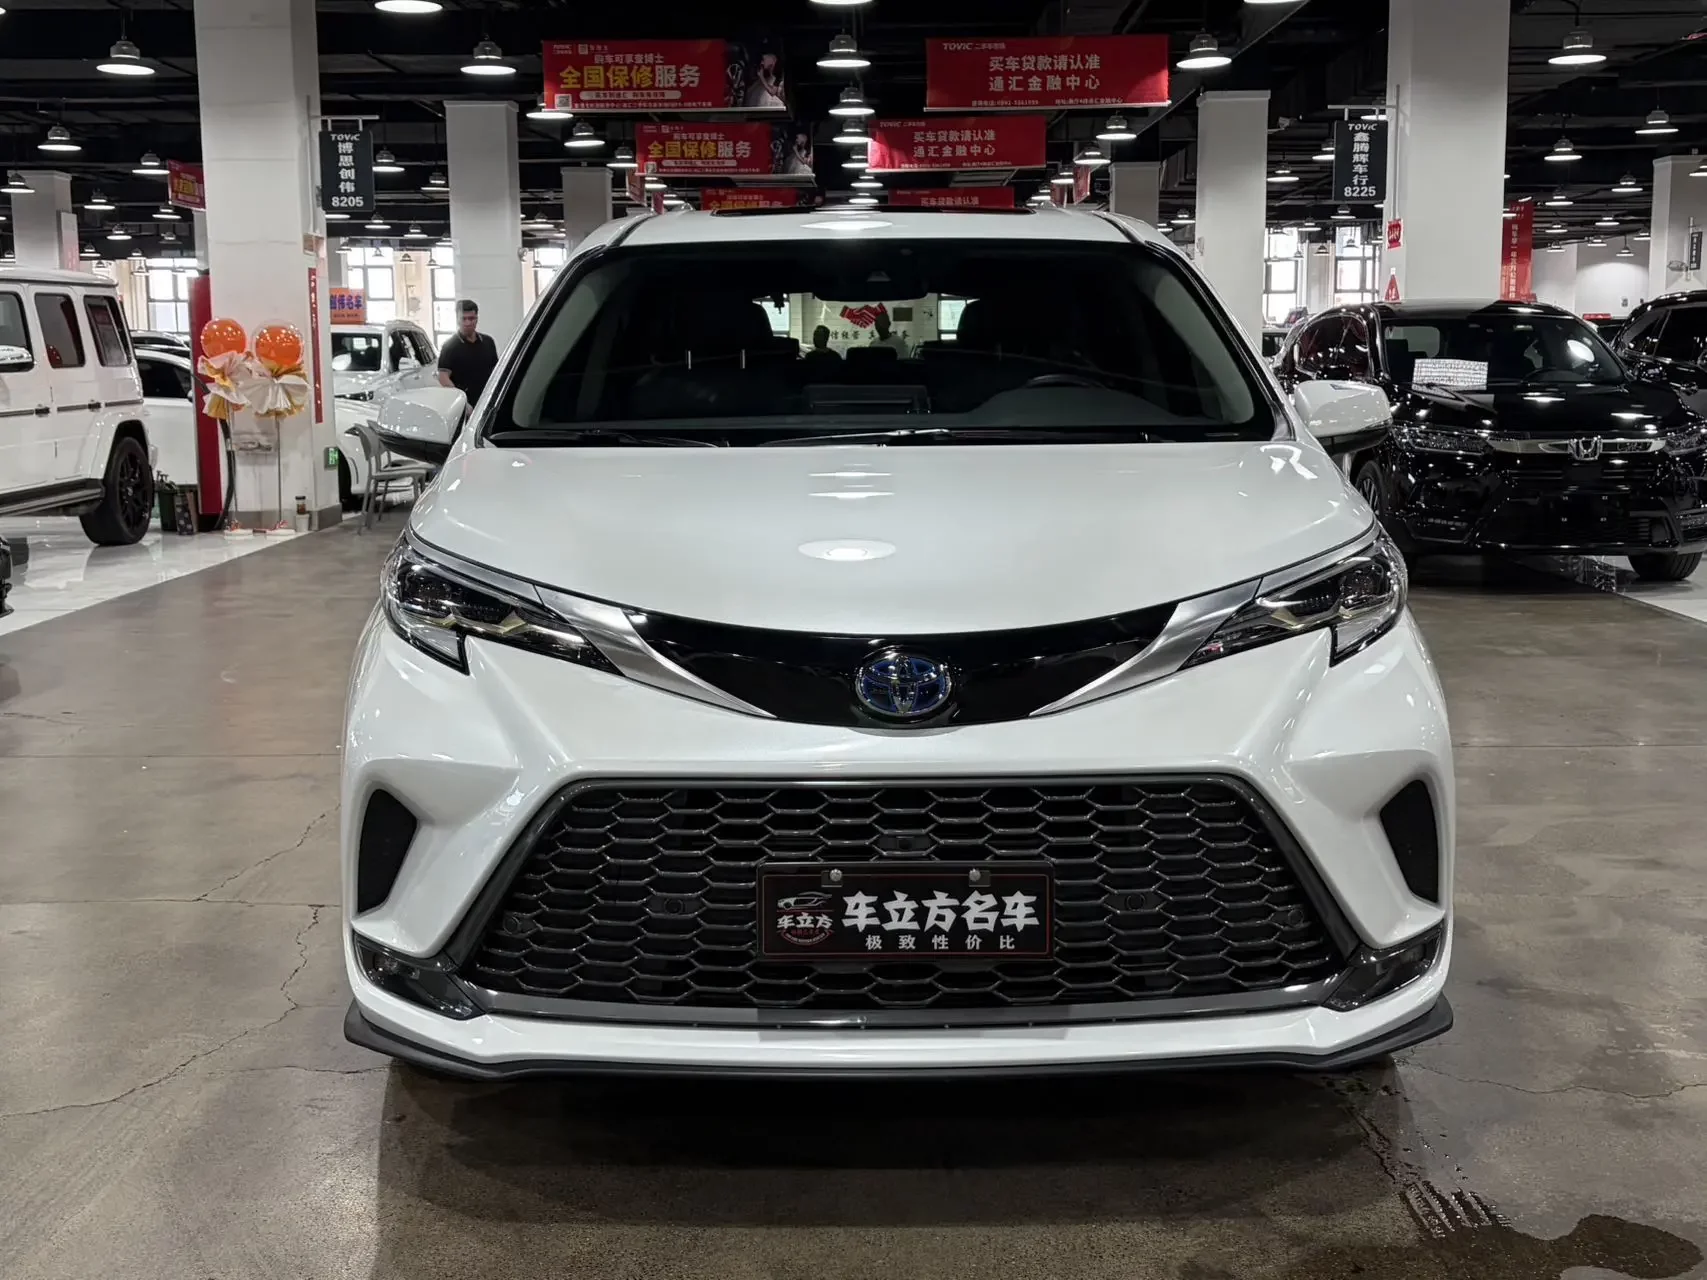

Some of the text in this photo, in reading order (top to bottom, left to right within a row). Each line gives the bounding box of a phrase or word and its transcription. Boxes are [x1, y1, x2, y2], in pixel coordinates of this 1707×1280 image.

[942, 42, 973, 51] TOVIC
[989, 54, 1101, 72] 买车贷款请认准
[559, 65, 701, 89] 全国保修服务
[988, 74, 1101, 92] 通汇金融中心
[1348, 123, 1378, 131] TOVIC
[330, 133, 360, 141] TOVIC
[913, 129, 996, 143] 买车贷款请认准
[647, 141, 752, 159] 全国保修服务
[913, 144, 996, 158] 通汇金融中心
[1344, 186, 1376, 197] 8225
[331, 196, 364, 207] 8205
[842, 890, 1040, 933] 车立方名车
[776, 911, 833, 930] 车立方
[865, 935, 1015, 951] 极致性价比
